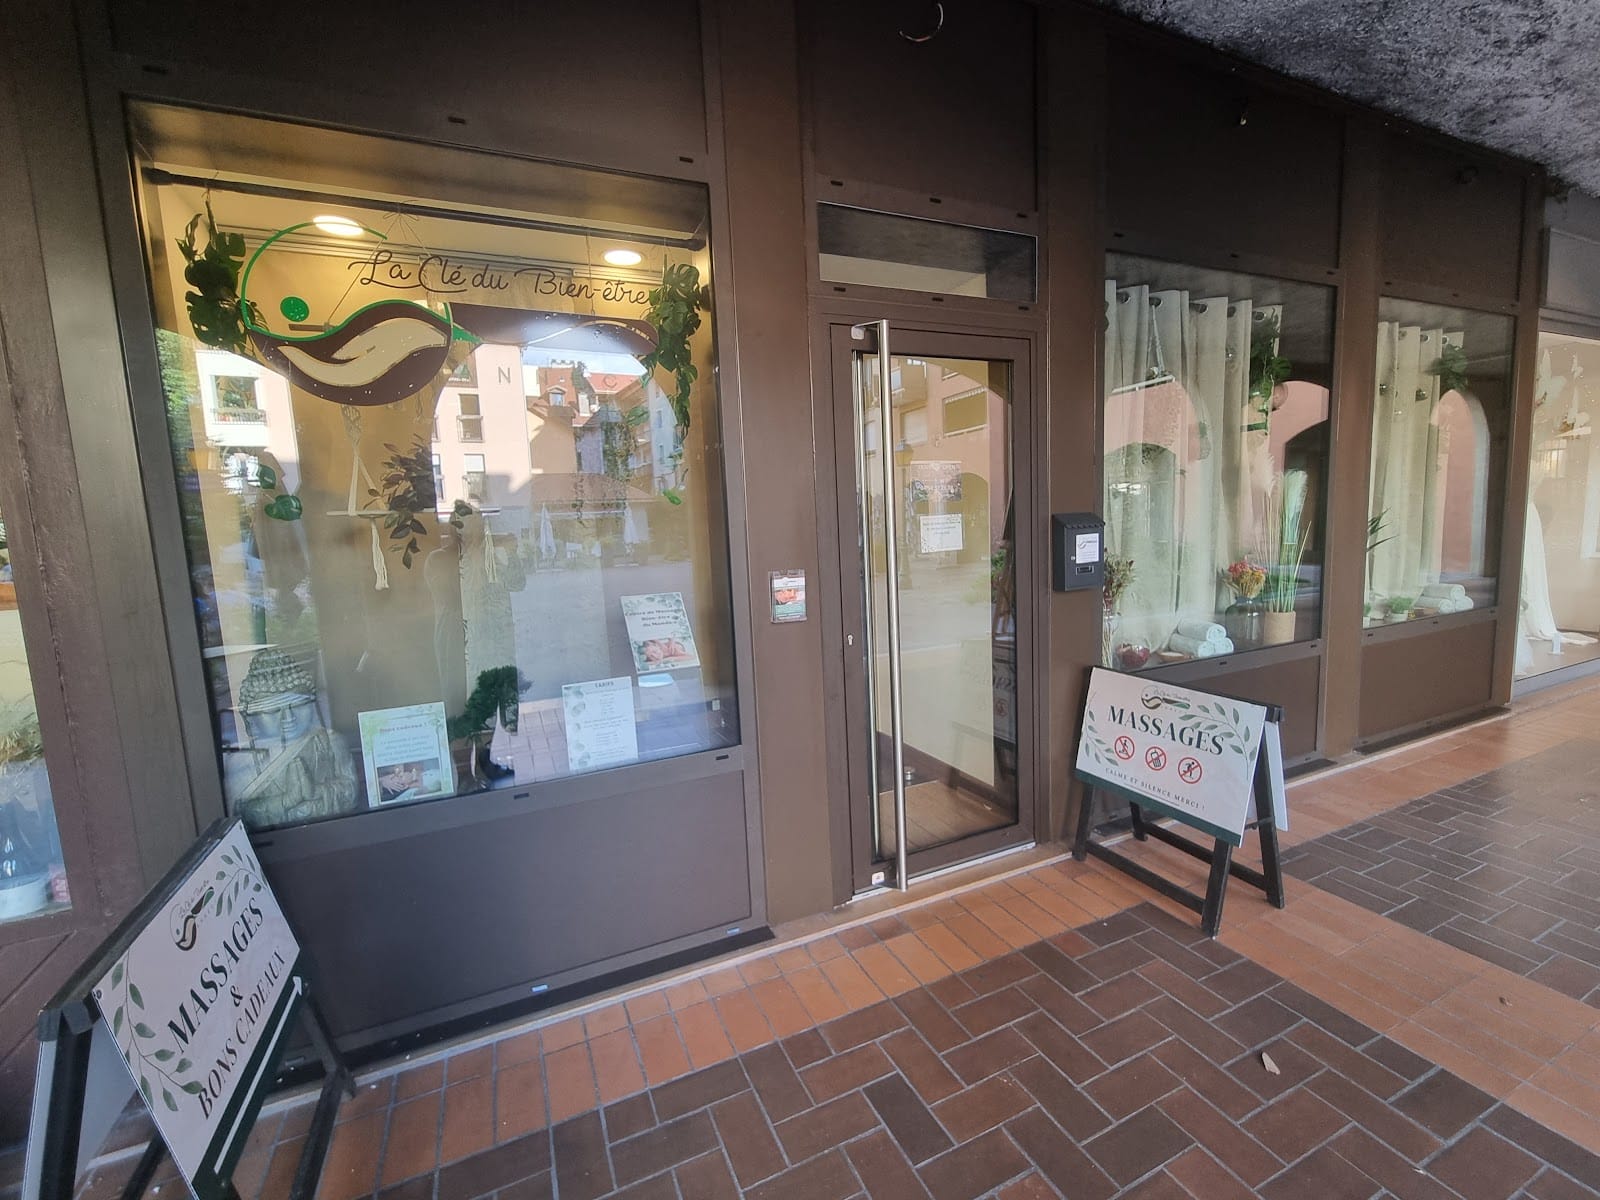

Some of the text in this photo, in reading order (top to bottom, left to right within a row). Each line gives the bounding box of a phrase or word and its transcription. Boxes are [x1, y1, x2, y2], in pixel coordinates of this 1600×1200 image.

[348, 250, 651, 305] La Clé du Bien-être
[1107, 705, 1225, 756] MASSAGES
[1105, 767, 1128, 780] CALME
[1130, 776, 1138, 785] ET
[1141, 780, 1171, 798] SILENCE
[1174, 794, 1200, 809] MERCI
[167, 897, 264, 1054] MASSAGES
[230, 985, 244, 1008] &
[198, 950, 286, 1120] BONS CADEAUX
